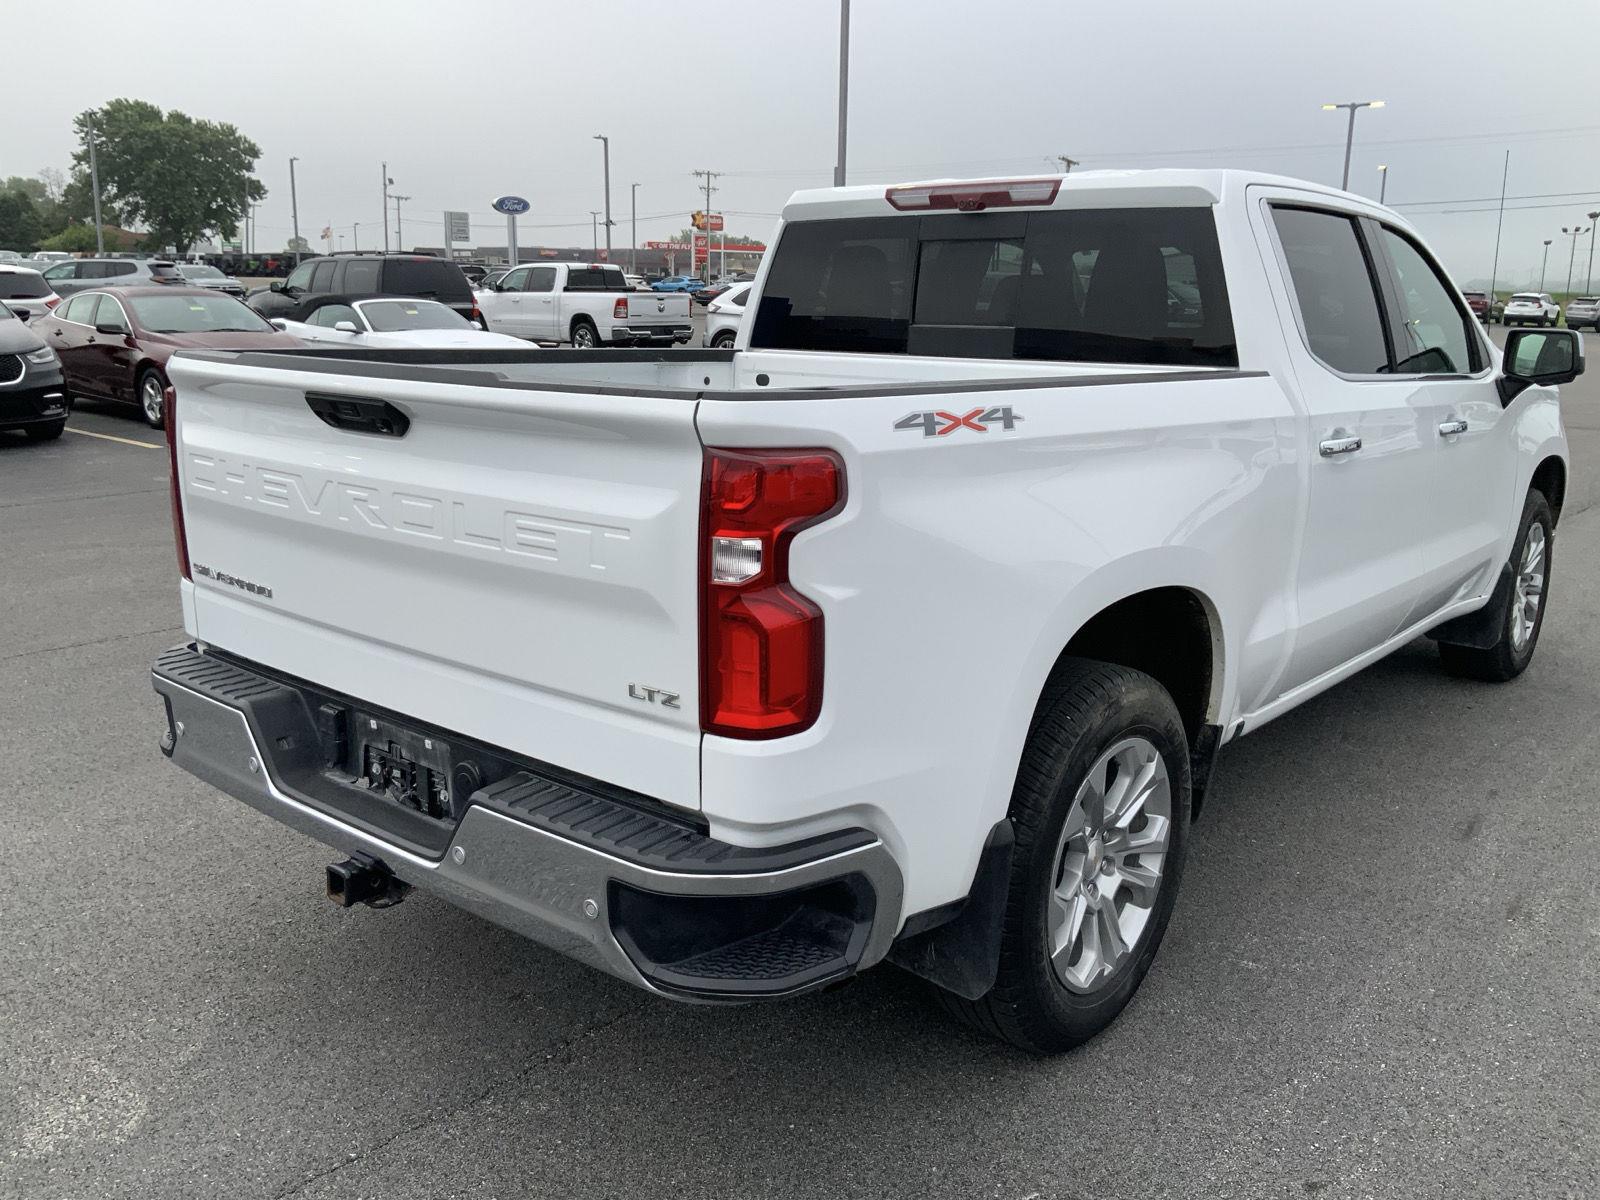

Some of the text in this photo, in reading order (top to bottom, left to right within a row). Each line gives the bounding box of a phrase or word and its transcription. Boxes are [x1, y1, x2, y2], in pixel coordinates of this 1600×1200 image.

[502, 200, 524, 211] Ford
[188, 453, 631, 570] CHEVROLET
[628, 683, 681, 709] LTZ
